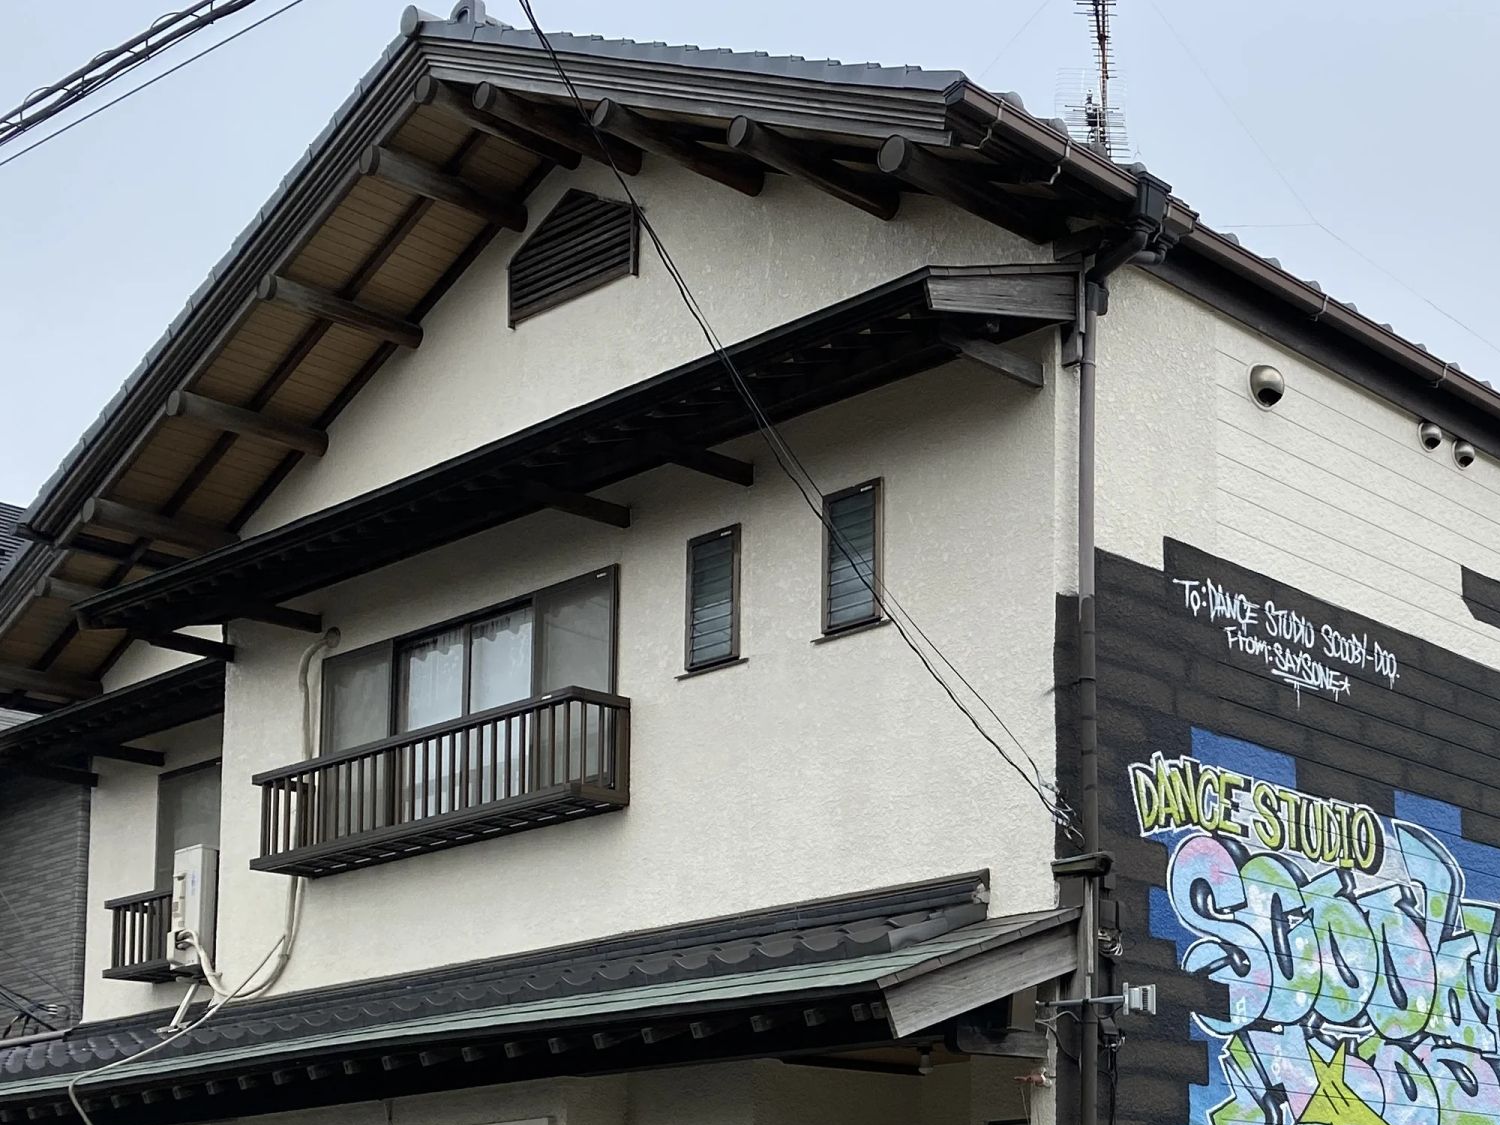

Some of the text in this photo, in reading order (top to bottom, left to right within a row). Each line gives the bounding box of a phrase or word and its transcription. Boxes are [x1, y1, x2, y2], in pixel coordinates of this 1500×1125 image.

[1207, 578, 1261, 624] DANCE
[1264, 600, 1315, 648] STUDIO
[1129, 753, 1385, 870] DANCE STUDIO
